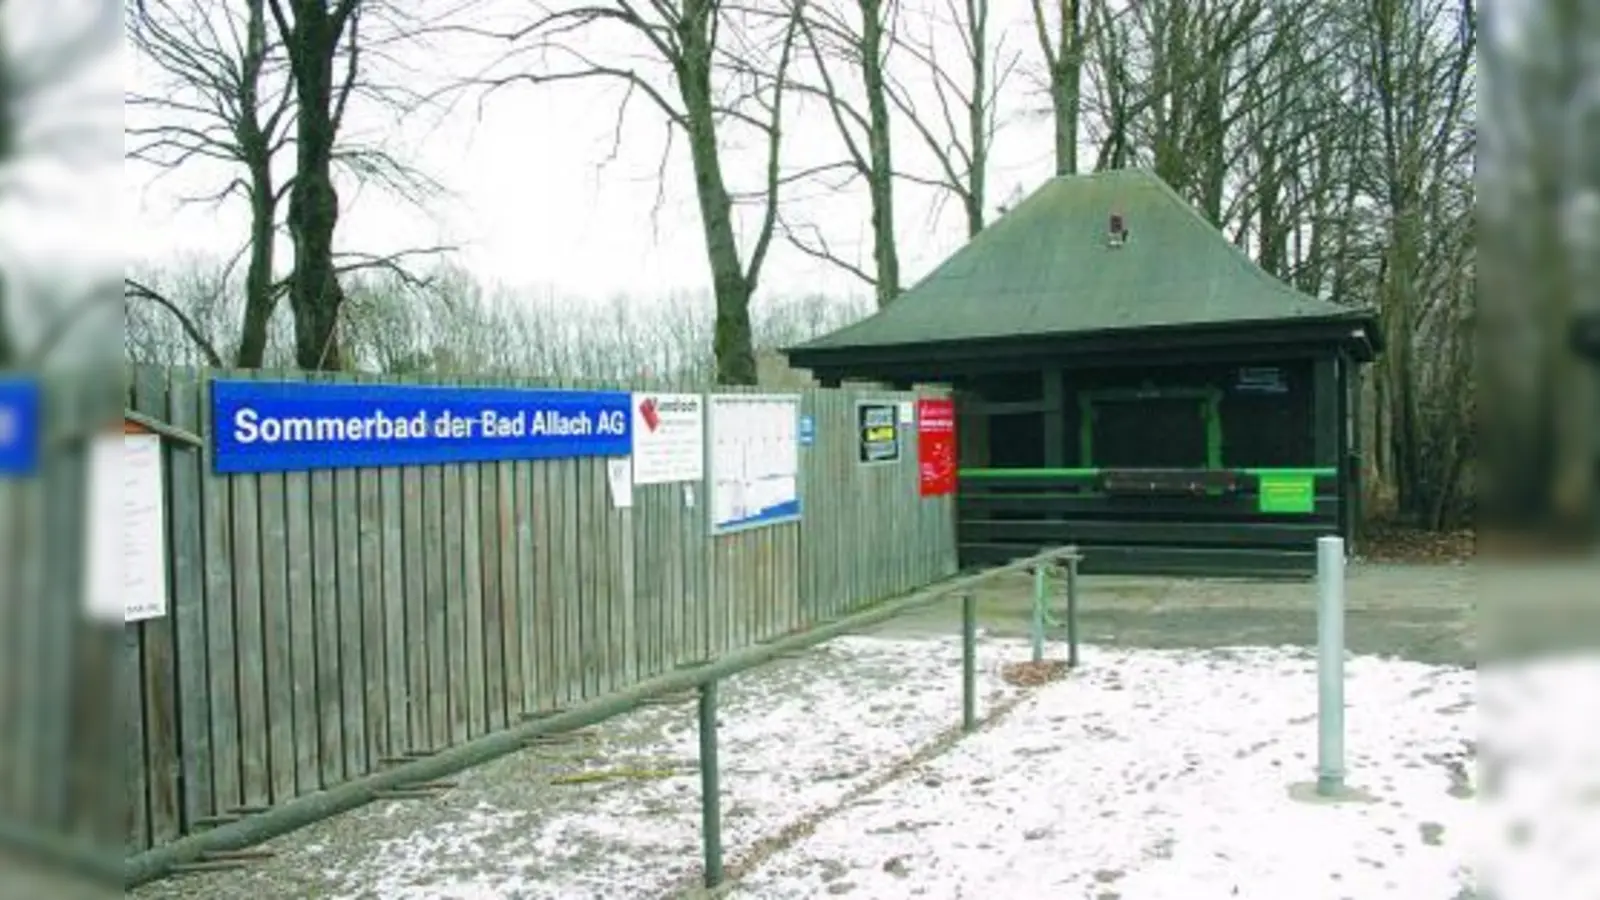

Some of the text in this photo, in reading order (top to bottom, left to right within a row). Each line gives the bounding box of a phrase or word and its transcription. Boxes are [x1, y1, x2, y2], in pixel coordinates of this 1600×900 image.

[234, 407, 626, 443] Sommerbad der Bad Allach AG
